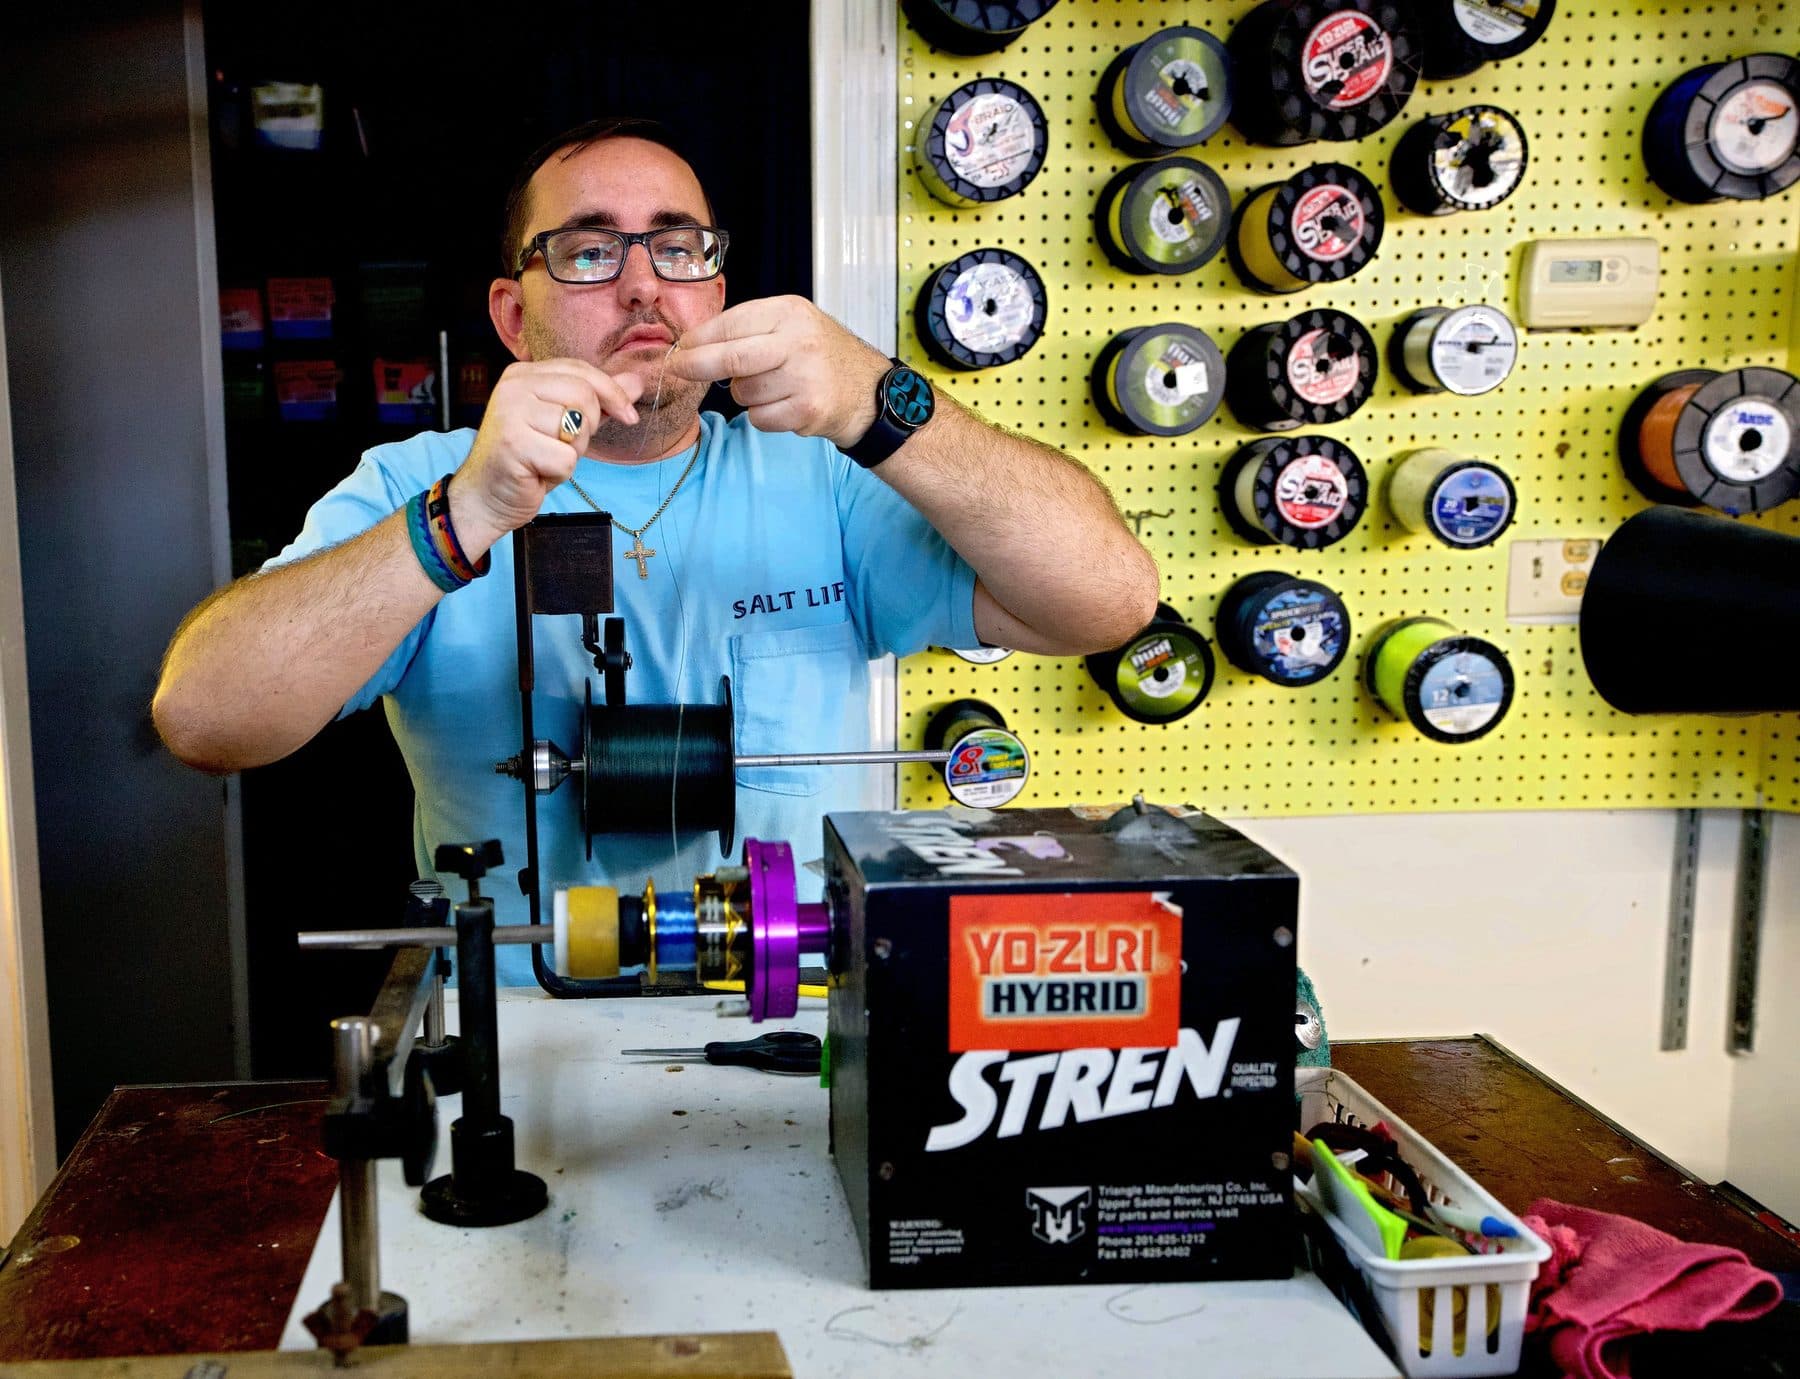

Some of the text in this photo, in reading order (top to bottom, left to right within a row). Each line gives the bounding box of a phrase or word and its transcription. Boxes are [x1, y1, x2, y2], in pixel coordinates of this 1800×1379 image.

[733, 581, 844, 619] SALT LIF
[1432, 689, 1449, 701] 12
[969, 928, 1153, 975] YO-ZURI
[992, 980, 1139, 1014] HYBRID
[1231, 1062, 1277, 1075] QUALITY
[925, 1018, 1241, 1152] STREN
[1098, 1185, 1143, 1198] Triangle
[1145, 1183, 1223, 1196] Manufacturing
[1249, 1182, 1270, 1192] Inc.
[1098, 1198, 1131, 1210] Upper
[1133, 1197, 1171, 1208] Saddle
[1173, 1196, 1205, 1208] River,
[1207, 1195, 1224, 1206] NJ
[1259, 1193, 1284, 1204] USA
[1097, 1207, 1239, 1222] For parts and service visit
[889, 1229, 963, 1239] Before removing
[916, 1237, 965, 1246] disconnect
[1097, 1236, 1133, 1247] Phone
[1097, 1249, 1118, 1260] Fax
